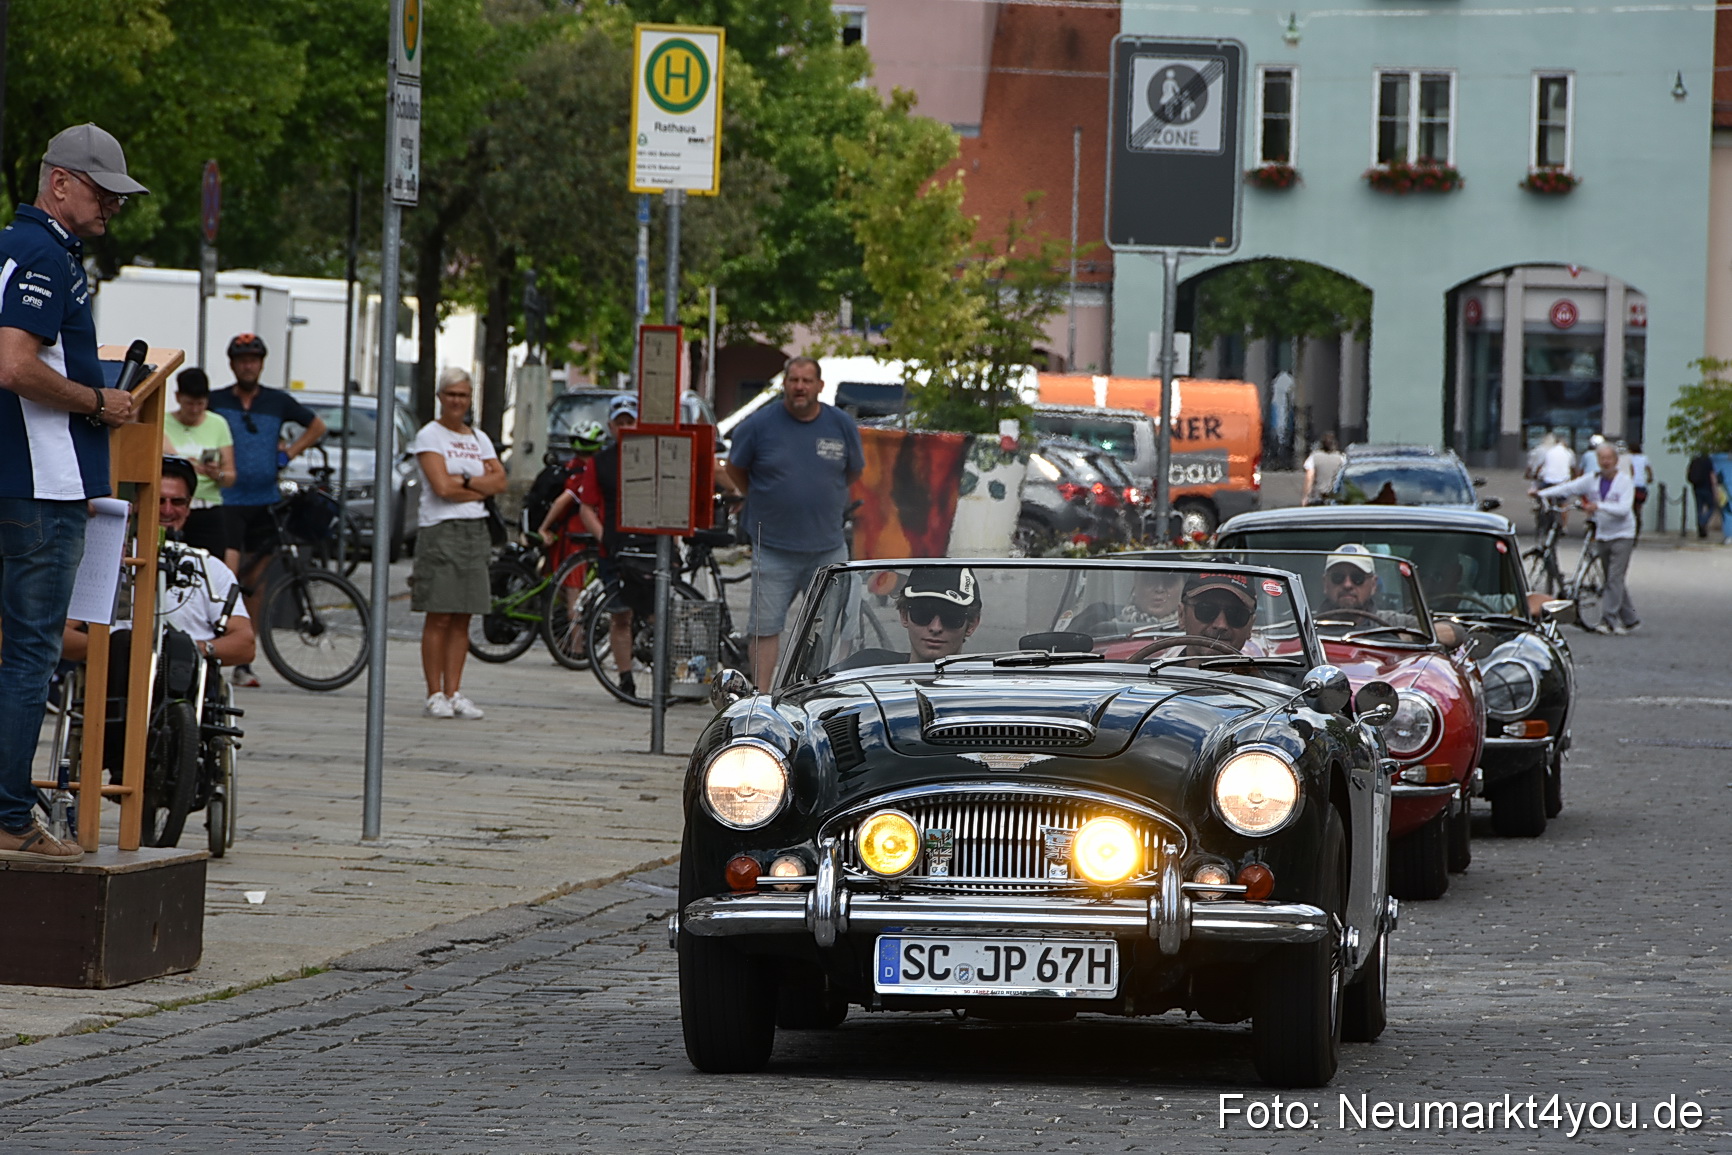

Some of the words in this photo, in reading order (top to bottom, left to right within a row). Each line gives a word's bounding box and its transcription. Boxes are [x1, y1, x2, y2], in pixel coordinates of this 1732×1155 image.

[654, 121, 697, 134] Rathaus
[1152, 128, 1200, 146] ZONE
[22, 294, 43, 307] ORIS
[902, 944, 951, 981] SC
[977, 945, 1027, 982] JP
[1036, 946, 1111, 984] 67H
[884, 966, 894, 978] D
